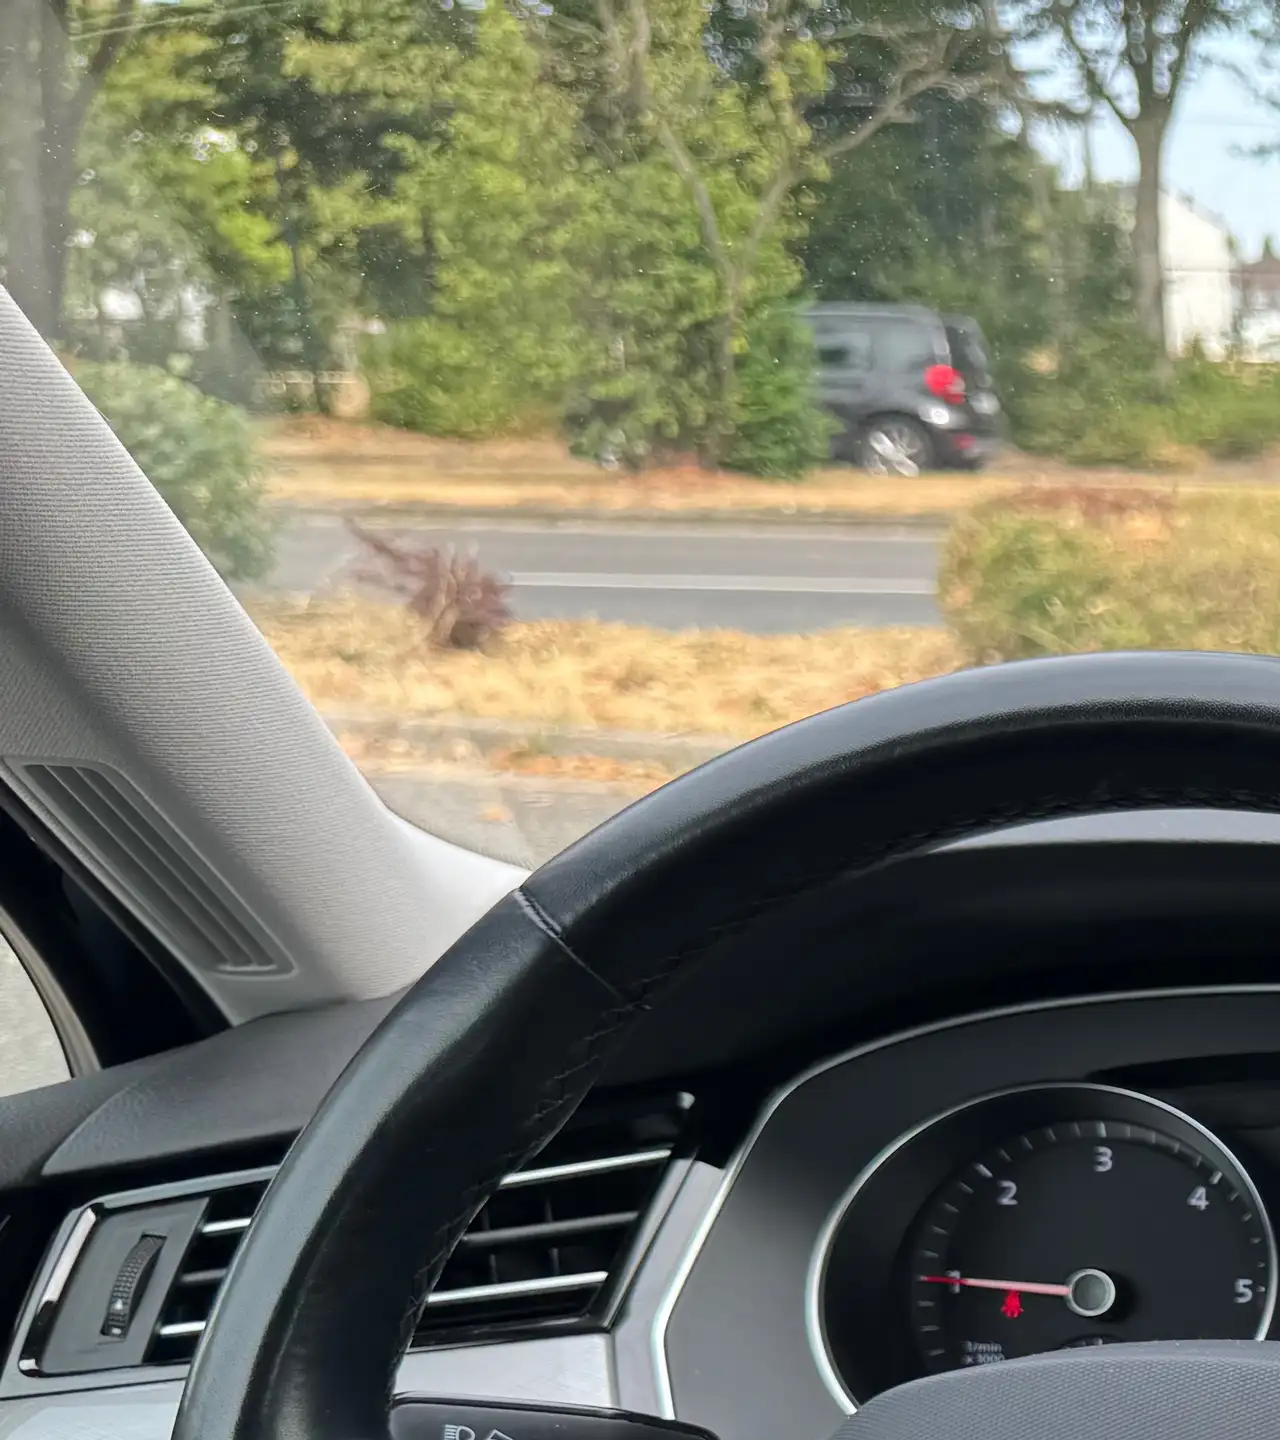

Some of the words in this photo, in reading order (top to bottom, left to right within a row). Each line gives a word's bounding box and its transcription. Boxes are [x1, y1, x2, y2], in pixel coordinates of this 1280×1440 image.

[1094, 1146, 1112, 1172] 3
[998, 1180, 1018, 1206] 2
[1187, 1186, 1209, 1211] 4
[1234, 1279, 1254, 1303] 5
